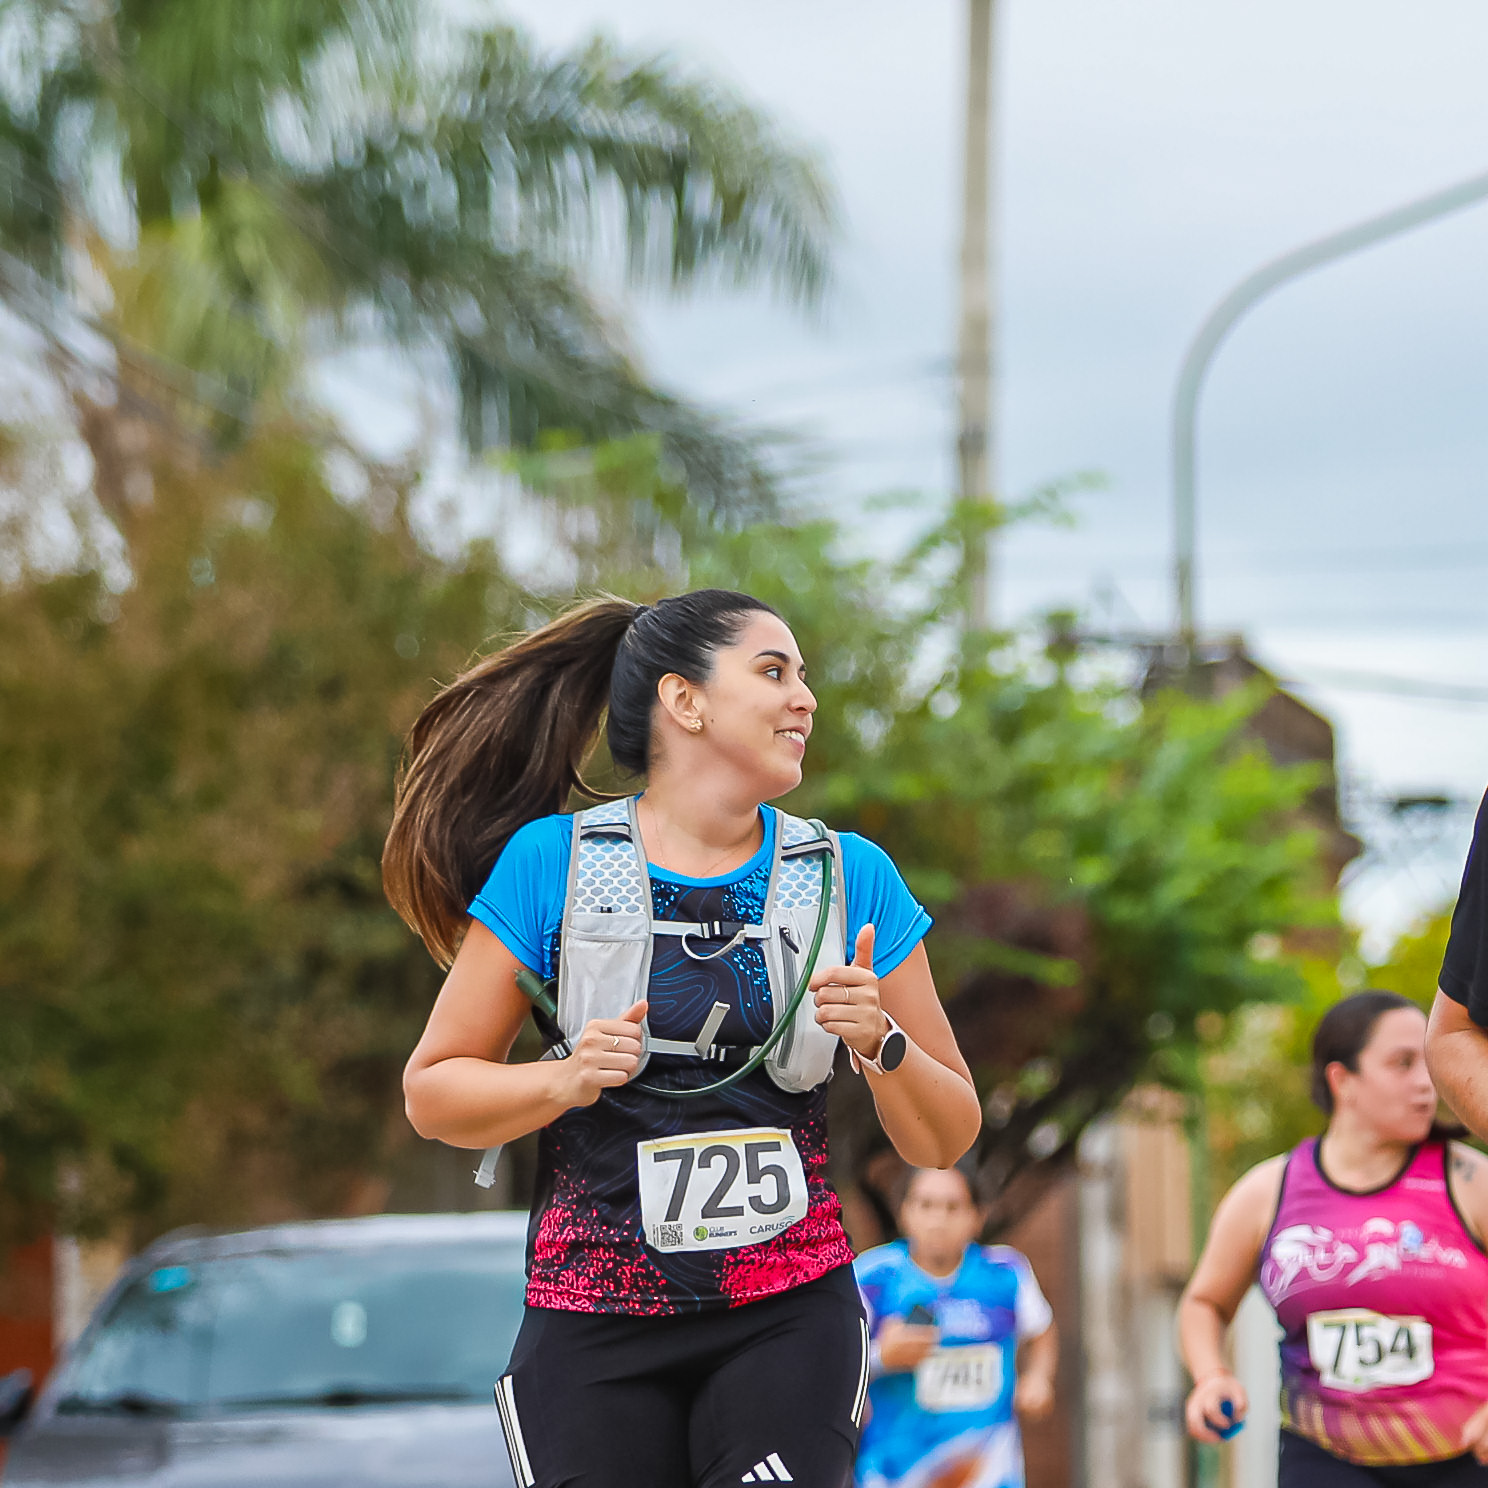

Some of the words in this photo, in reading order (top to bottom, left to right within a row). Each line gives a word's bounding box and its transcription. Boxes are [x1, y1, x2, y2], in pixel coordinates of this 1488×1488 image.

[654, 1141, 791, 1222] 725
[749, 1221, 793, 1234] CARUSO
[1323, 1321, 1416, 1375] 754
